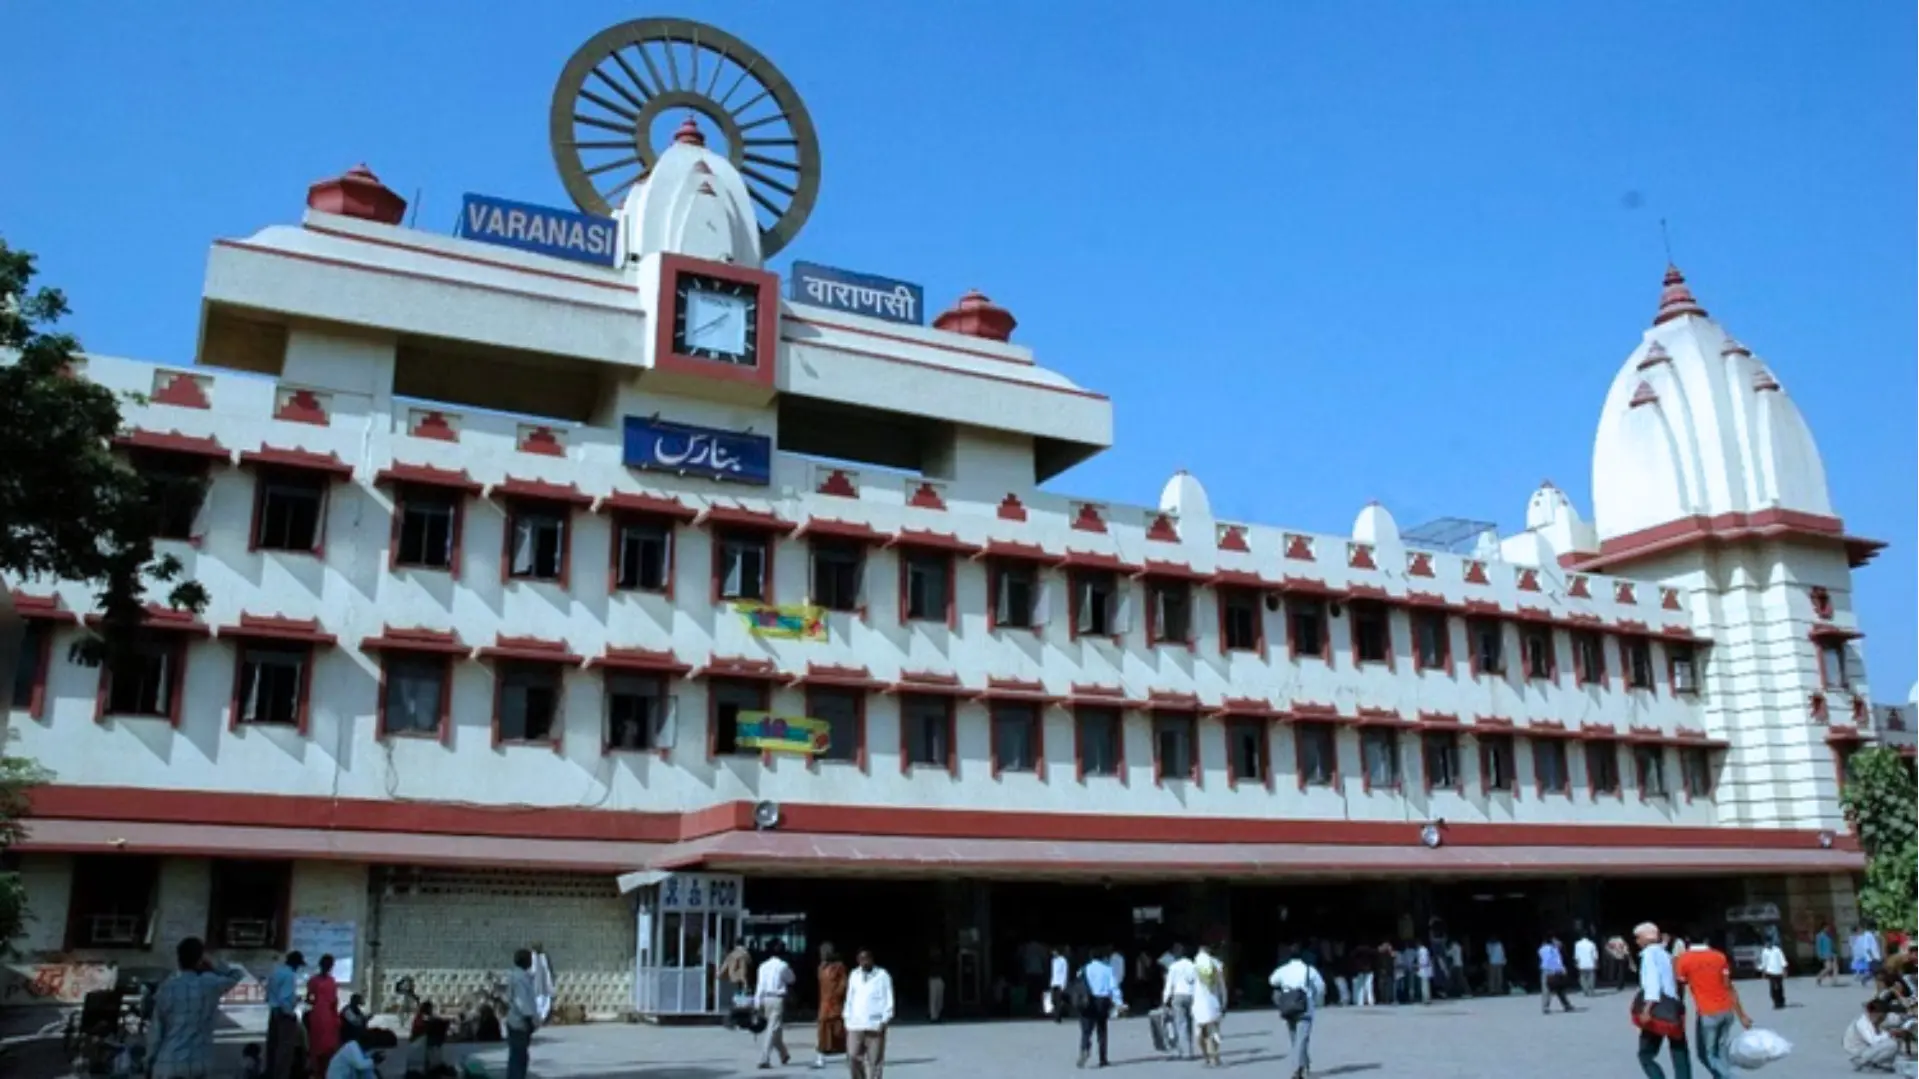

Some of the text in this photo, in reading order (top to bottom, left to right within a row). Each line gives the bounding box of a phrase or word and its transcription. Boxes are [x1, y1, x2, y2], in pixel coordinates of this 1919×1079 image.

[469, 203, 613, 255] VARANASI
[803, 275, 914, 320] वाराणसी
[654, 434, 741, 472] بنارس
